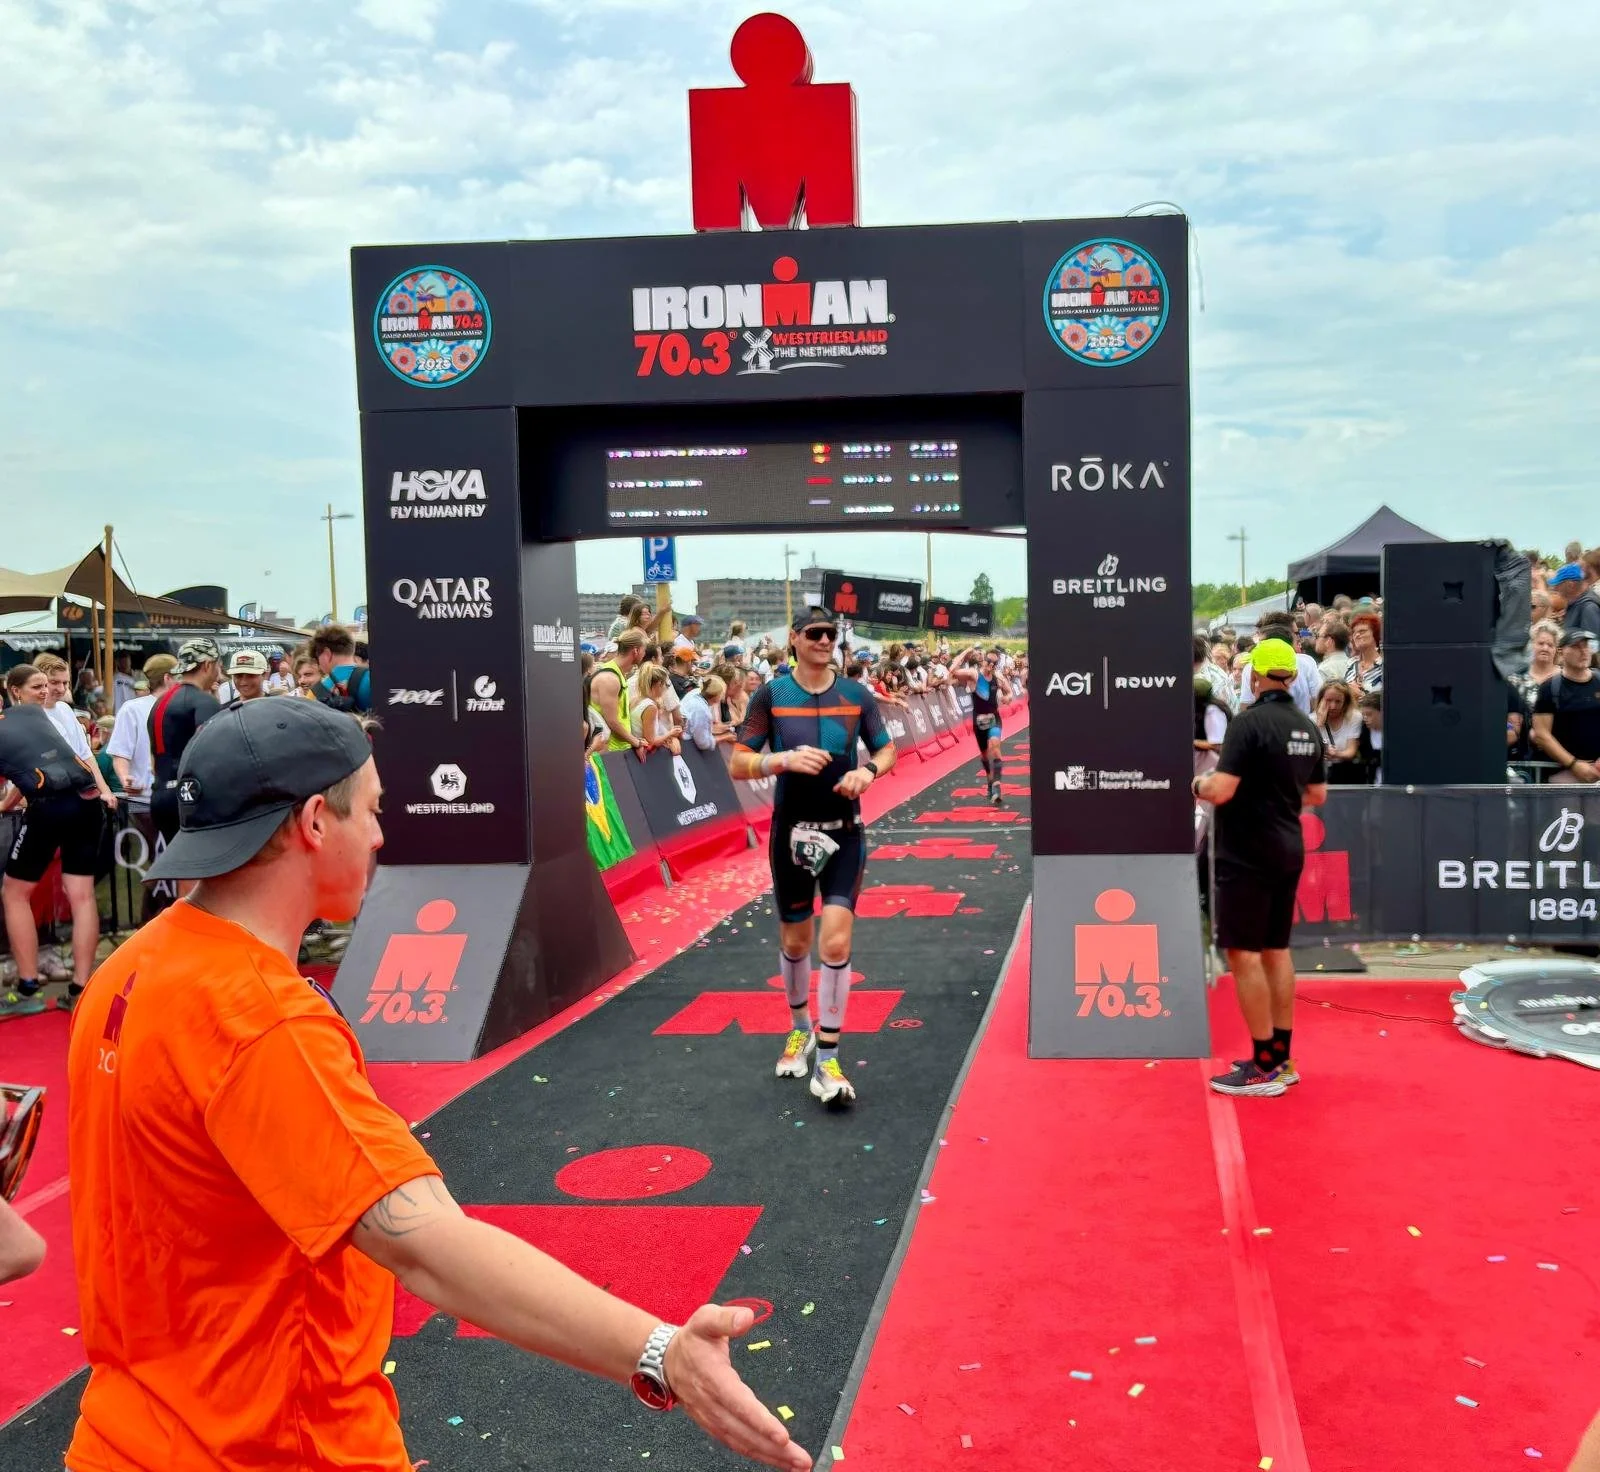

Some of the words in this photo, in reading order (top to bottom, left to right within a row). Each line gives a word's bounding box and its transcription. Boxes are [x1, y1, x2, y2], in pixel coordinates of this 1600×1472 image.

[632, 256, 889, 331] IRONMAN
[1051, 282, 1129, 307] IRONMAN
[1129, 289, 1160, 304] 70.3
[381, 308, 454, 331] IRONMAN
[454, 314, 483, 329] 70.3
[772, 329, 889, 346] WESTFRIESLAND
[634, 331, 732, 376] 70.3
[773, 347, 797, 358] THE
[799, 344, 888, 357] NETHERLANDS
[418, 357, 453, 371] 2025
[390, 469, 487, 501] HOKA
[390, 505, 412, 519] FLY
[413, 504, 463, 518] HUMAN
[464, 503, 487, 517] FLY
[649, 536, 669, 561] P
[392, 577, 492, 609] QATAR
[1052, 577, 1167, 595] BREITLING
[418, 602, 494, 619] AIRWAYS
[1093, 596, 1126, 609] 1884
[1114, 676, 1177, 689] ROUVY
[1287, 740, 1316, 756] STAFF
[1528, 897, 1598, 921] 1884
[359, 991, 446, 1024] 70.3
[1075, 984, 1163, 1018] 70.3
